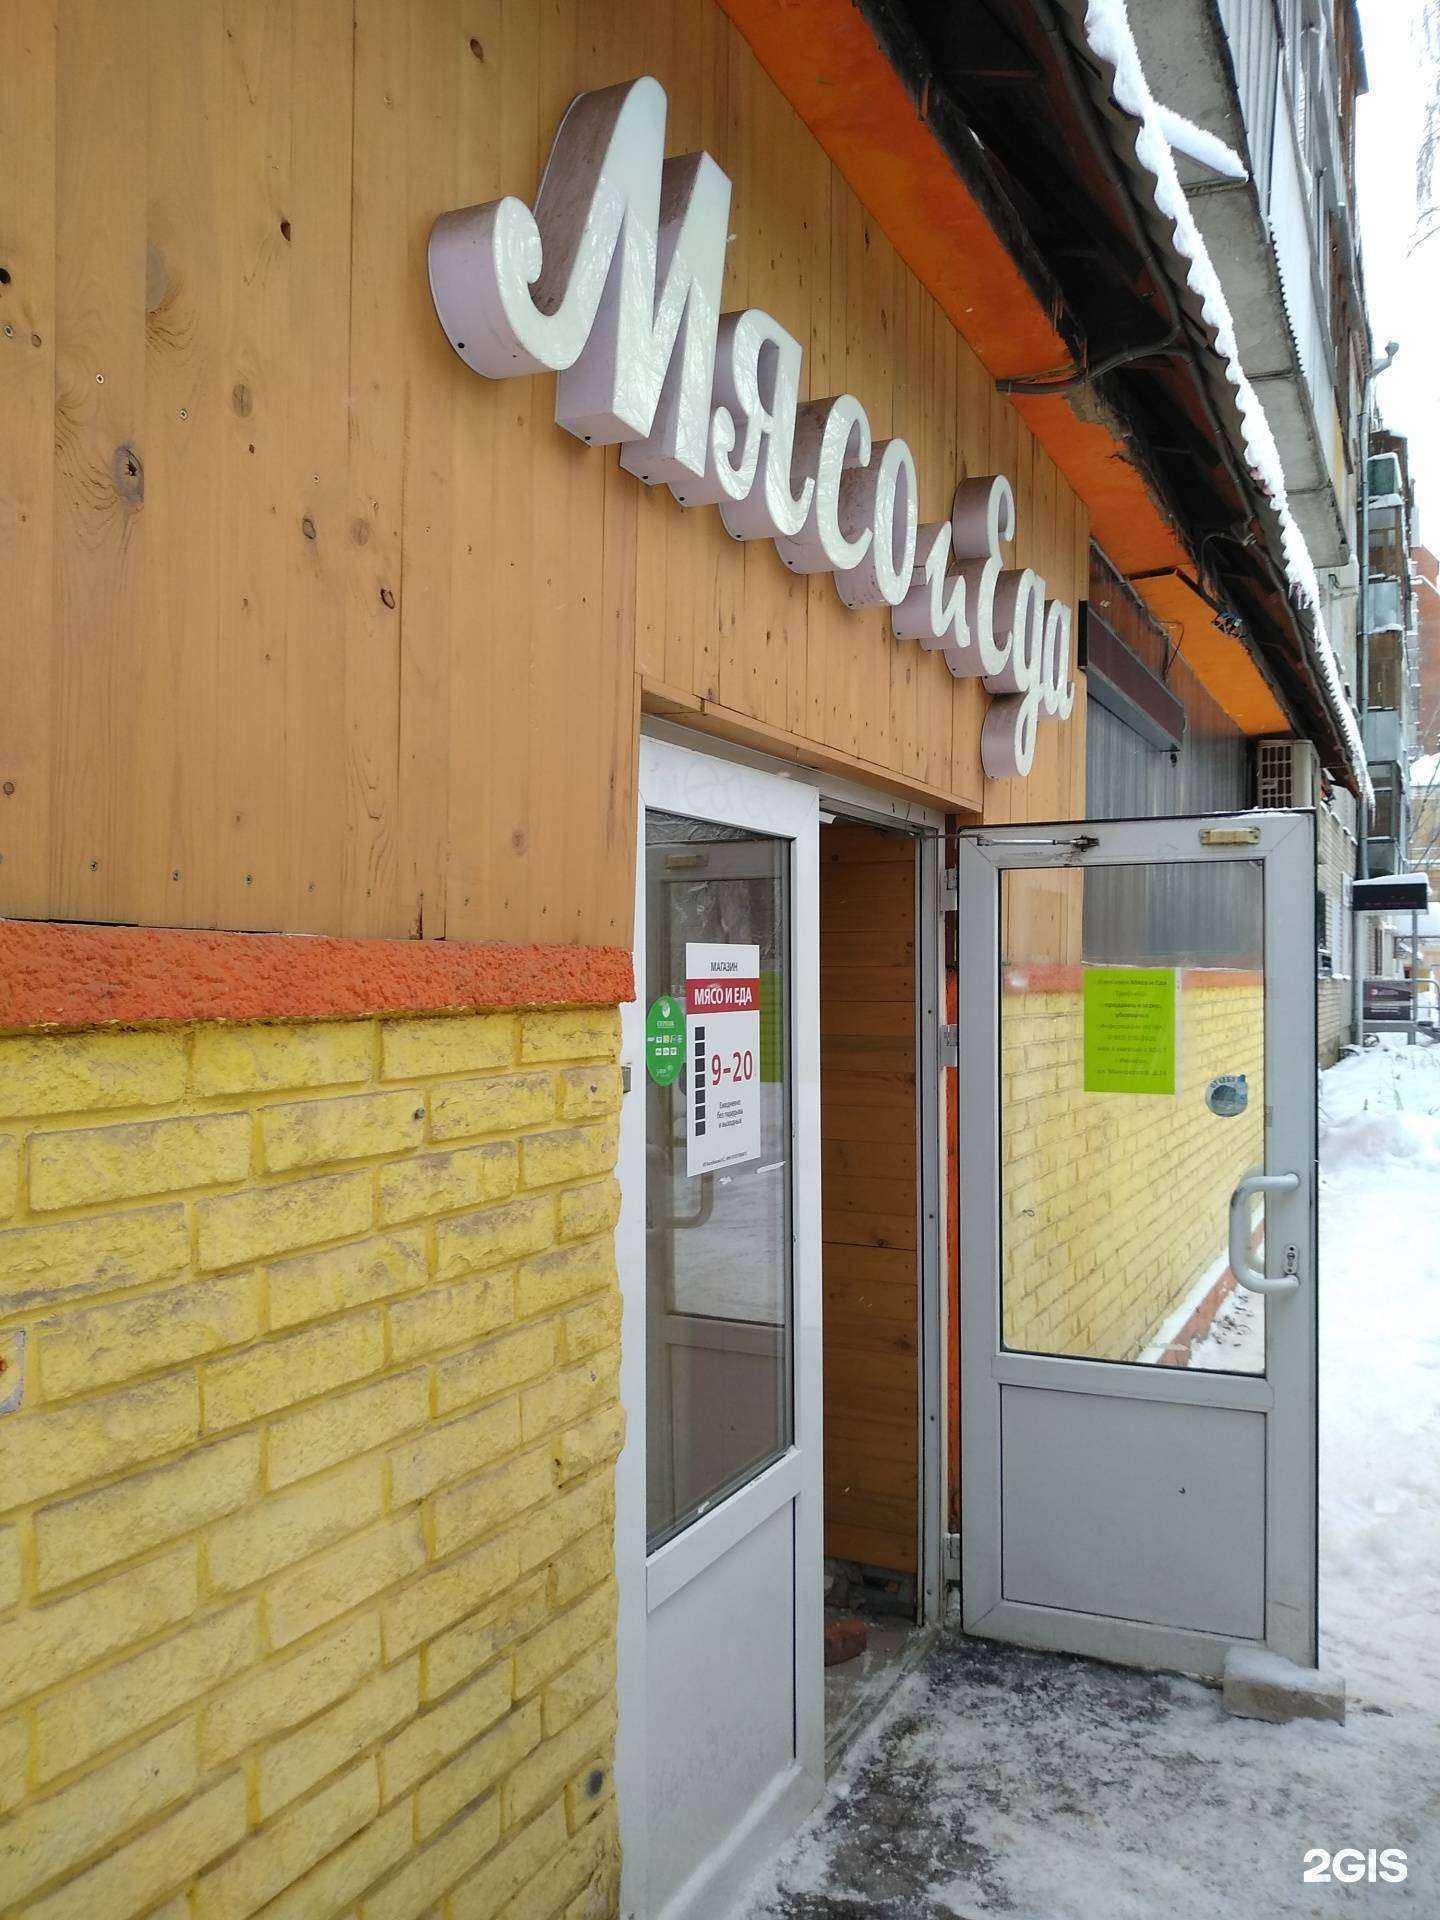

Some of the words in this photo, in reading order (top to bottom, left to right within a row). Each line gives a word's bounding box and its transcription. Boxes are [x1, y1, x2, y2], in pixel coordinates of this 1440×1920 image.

[490, 75, 919, 606] Мясо
[924, 520, 971, 648] и
[977, 474, 1077, 778] Еда
[710, 961, 738, 972] МАГАЗИН
[694, 988, 724, 1006] МЯСО
[725, 987, 733, 1004] И
[734, 986, 753, 1006] ЕДА
[711, 1050, 753, 1086] 9-20
